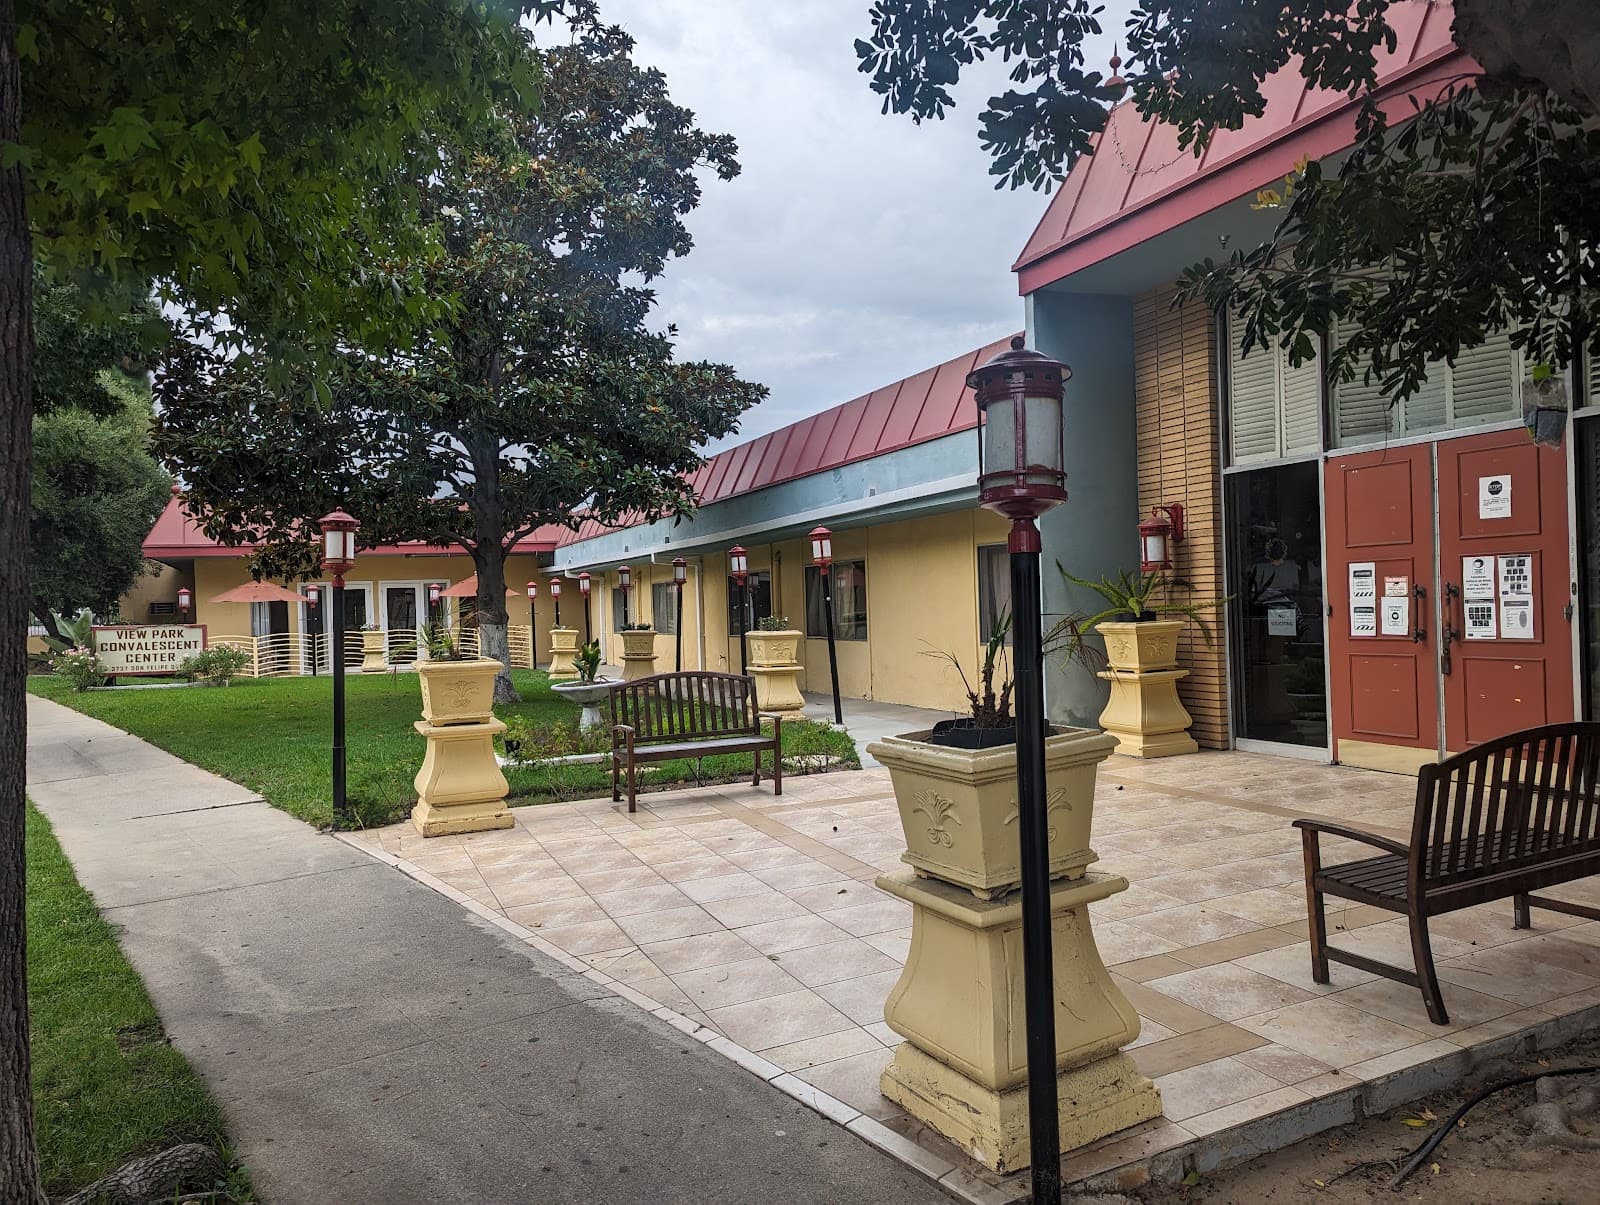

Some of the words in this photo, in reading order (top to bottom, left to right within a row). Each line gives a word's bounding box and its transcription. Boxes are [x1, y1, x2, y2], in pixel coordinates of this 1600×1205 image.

[117, 630, 147, 640] VIEW
[152, 629, 184, 639] PARK
[100, 640, 200, 652] CONVALESCENT
[126, 652, 176, 663] CENTER
